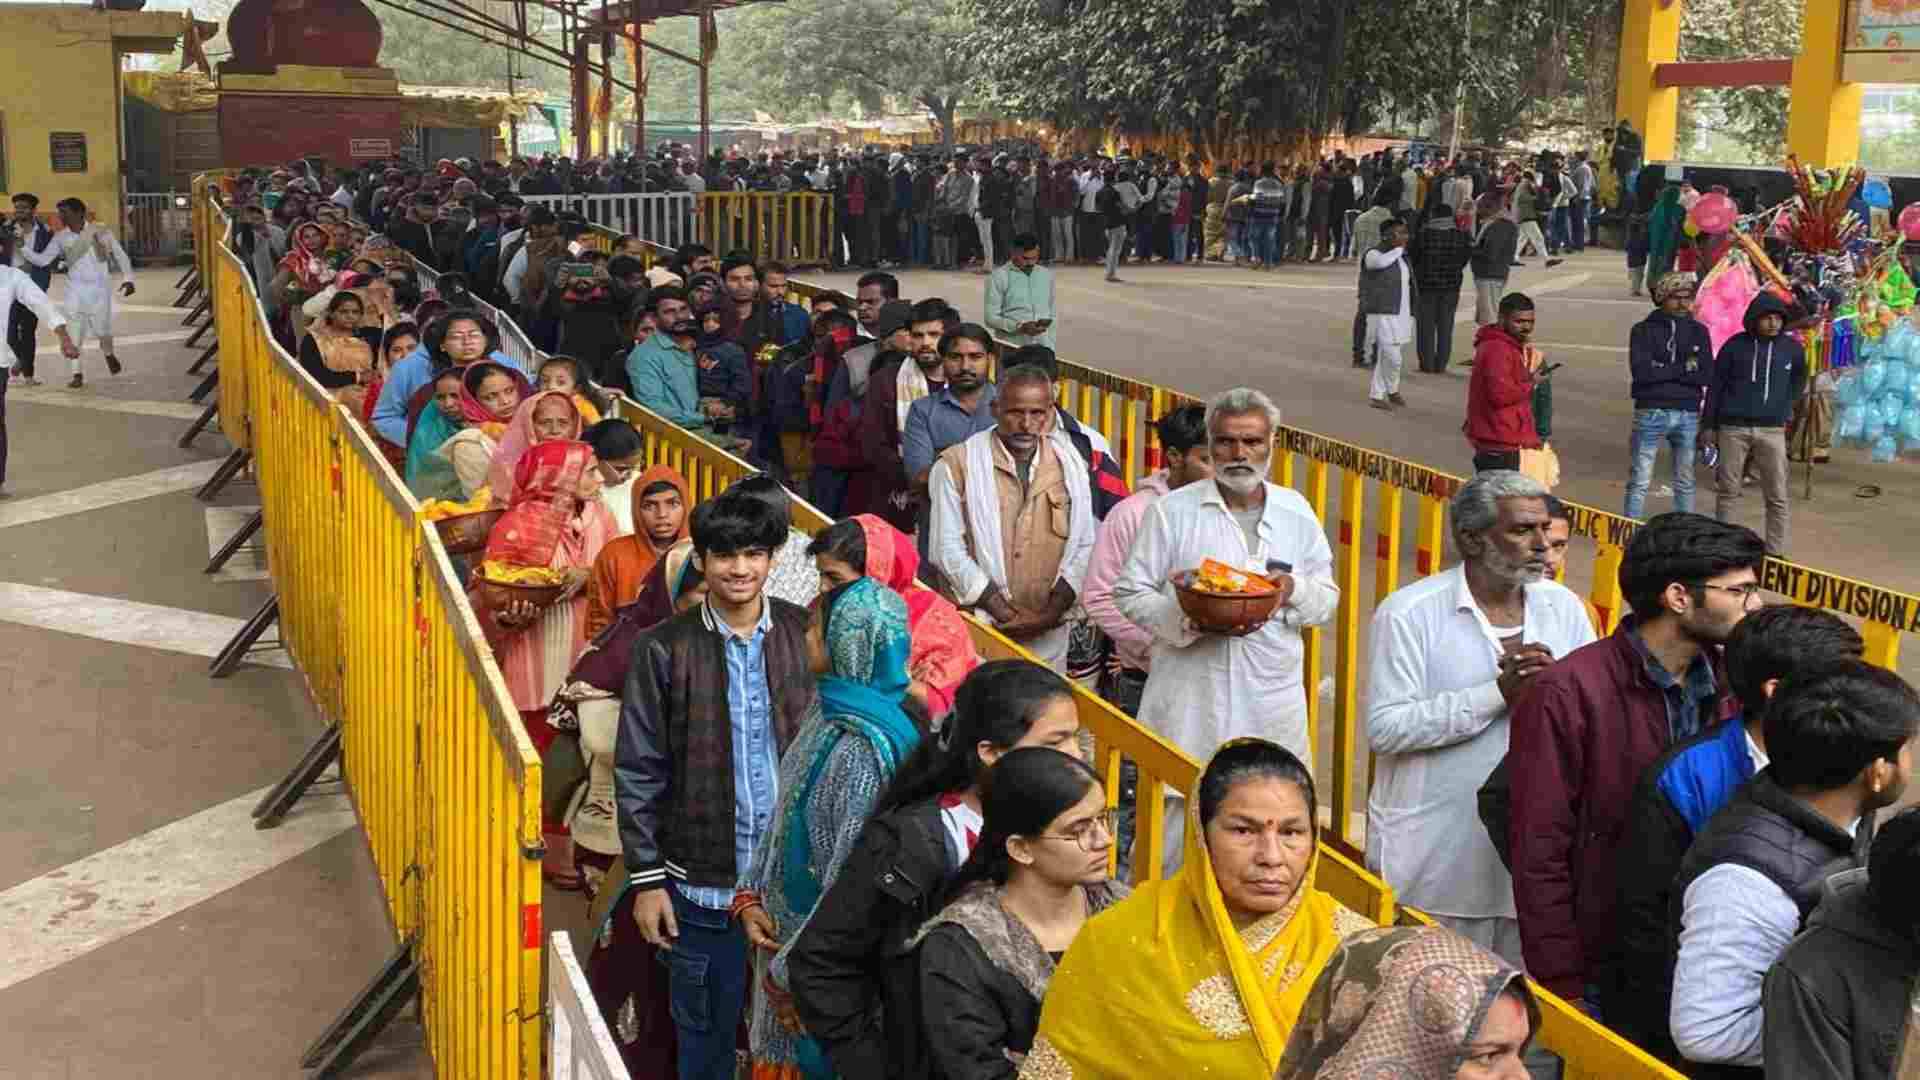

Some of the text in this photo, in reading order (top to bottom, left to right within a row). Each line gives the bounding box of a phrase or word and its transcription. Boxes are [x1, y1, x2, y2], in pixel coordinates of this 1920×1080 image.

[1313, 438, 1359, 473] DIVISION
[1608, 515, 1633, 546] WO
[1763, 559, 1805, 600] ENT
[1806, 571, 1907, 628] DIVISION
